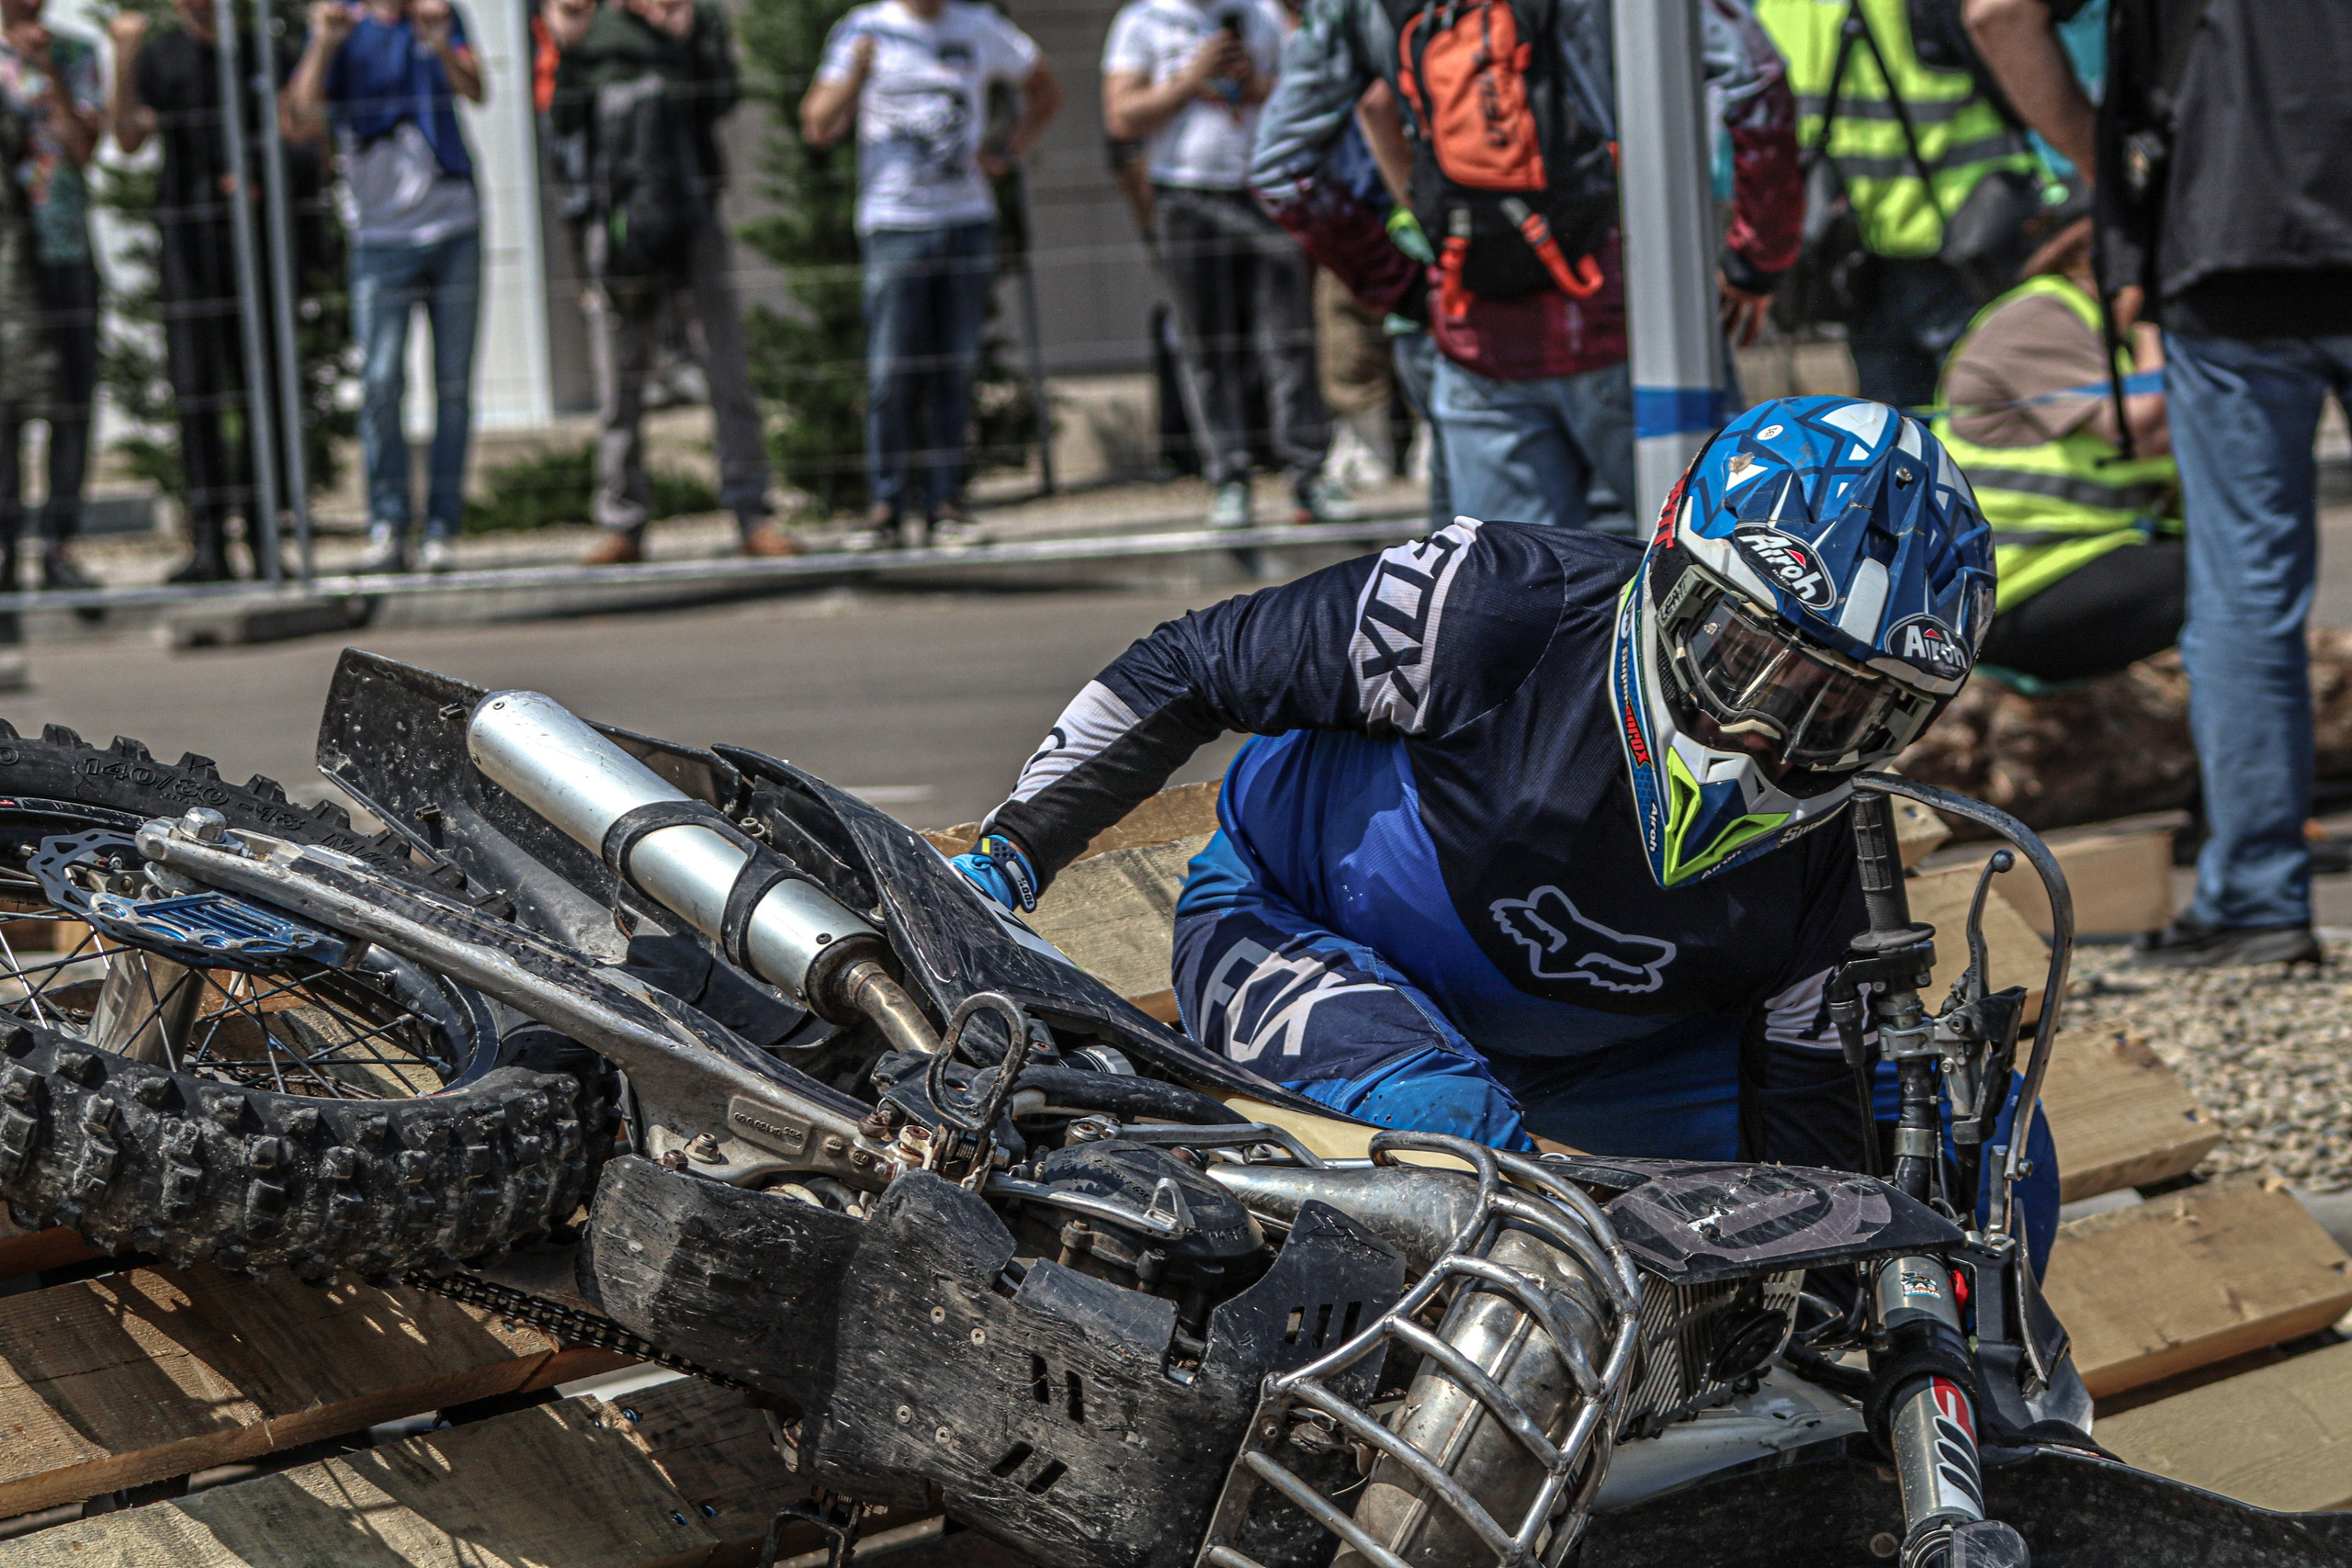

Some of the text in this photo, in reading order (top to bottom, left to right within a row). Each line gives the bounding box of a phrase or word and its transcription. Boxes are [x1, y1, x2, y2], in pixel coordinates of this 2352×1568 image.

[1737, 535, 1823, 600] Airoh
[1903, 625, 1967, 669] Airoh
[1648, 801, 1658, 852] Airoh
[1018, 877, 1034, 906] 100%
[1200, 937, 1395, 1063] FOX
